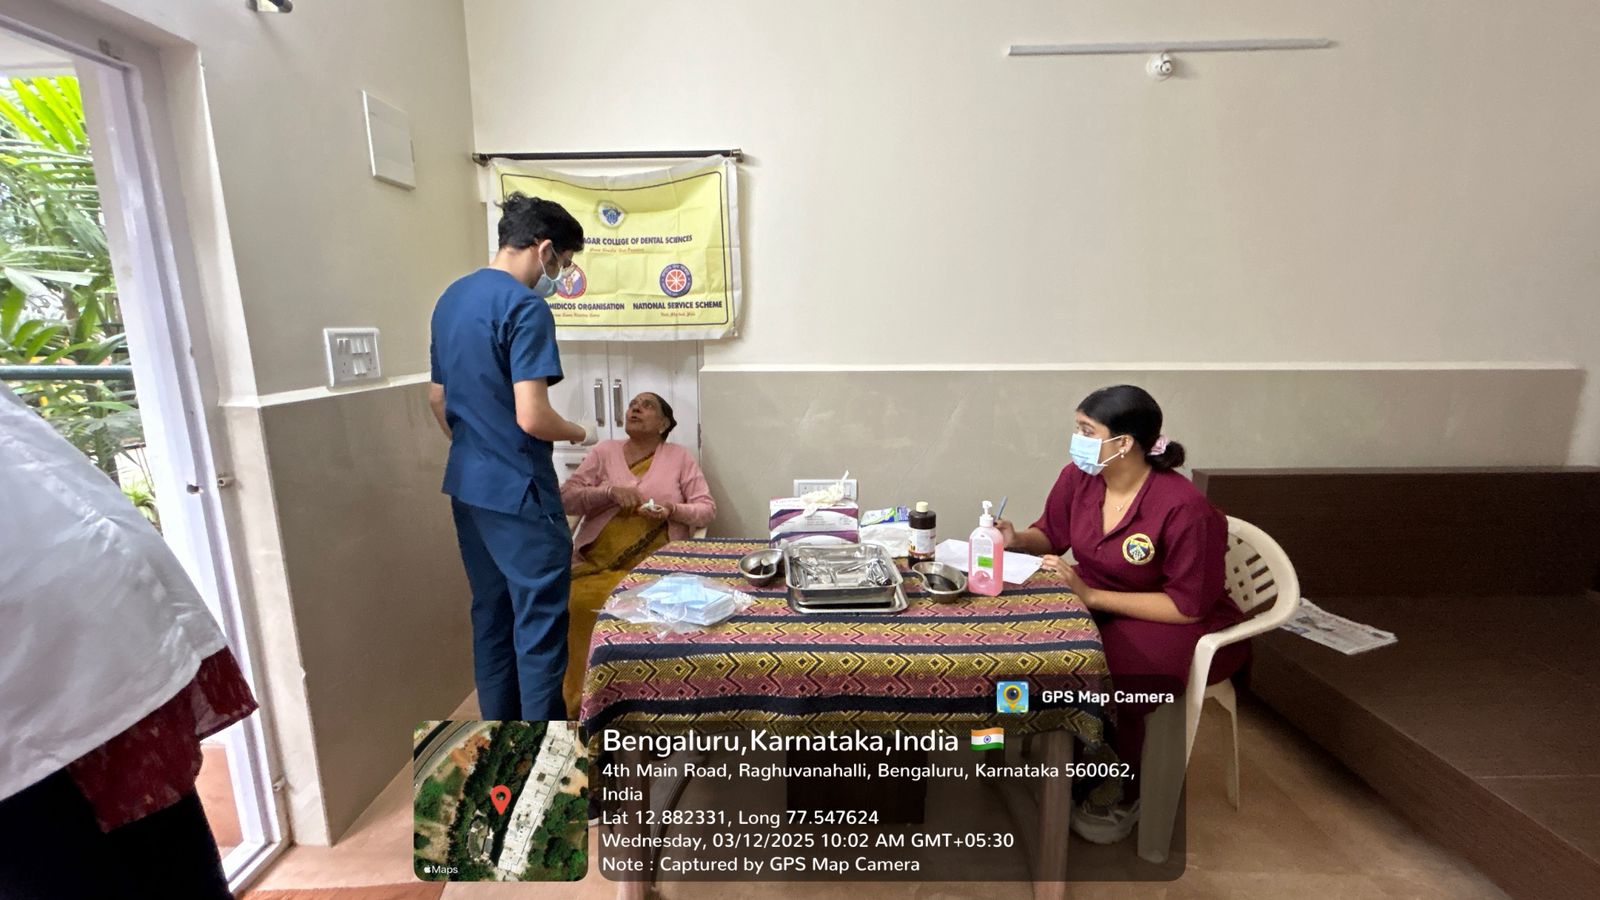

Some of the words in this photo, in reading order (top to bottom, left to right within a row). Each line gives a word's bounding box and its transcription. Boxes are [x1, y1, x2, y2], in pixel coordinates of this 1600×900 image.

[583, 236, 601, 246] AGAR
[602, 237, 629, 246] COLLEGE
[630, 236, 640, 245] OF
[640, 235, 664, 245] DENTAL
[665, 234, 693, 244] SCIENCES
[577, 303, 625, 311] ORGANISATION
[632, 302, 666, 310] NATIONAL
[667, 301, 694, 309] SERVICE
[695, 300, 723, 309] SCHEME
